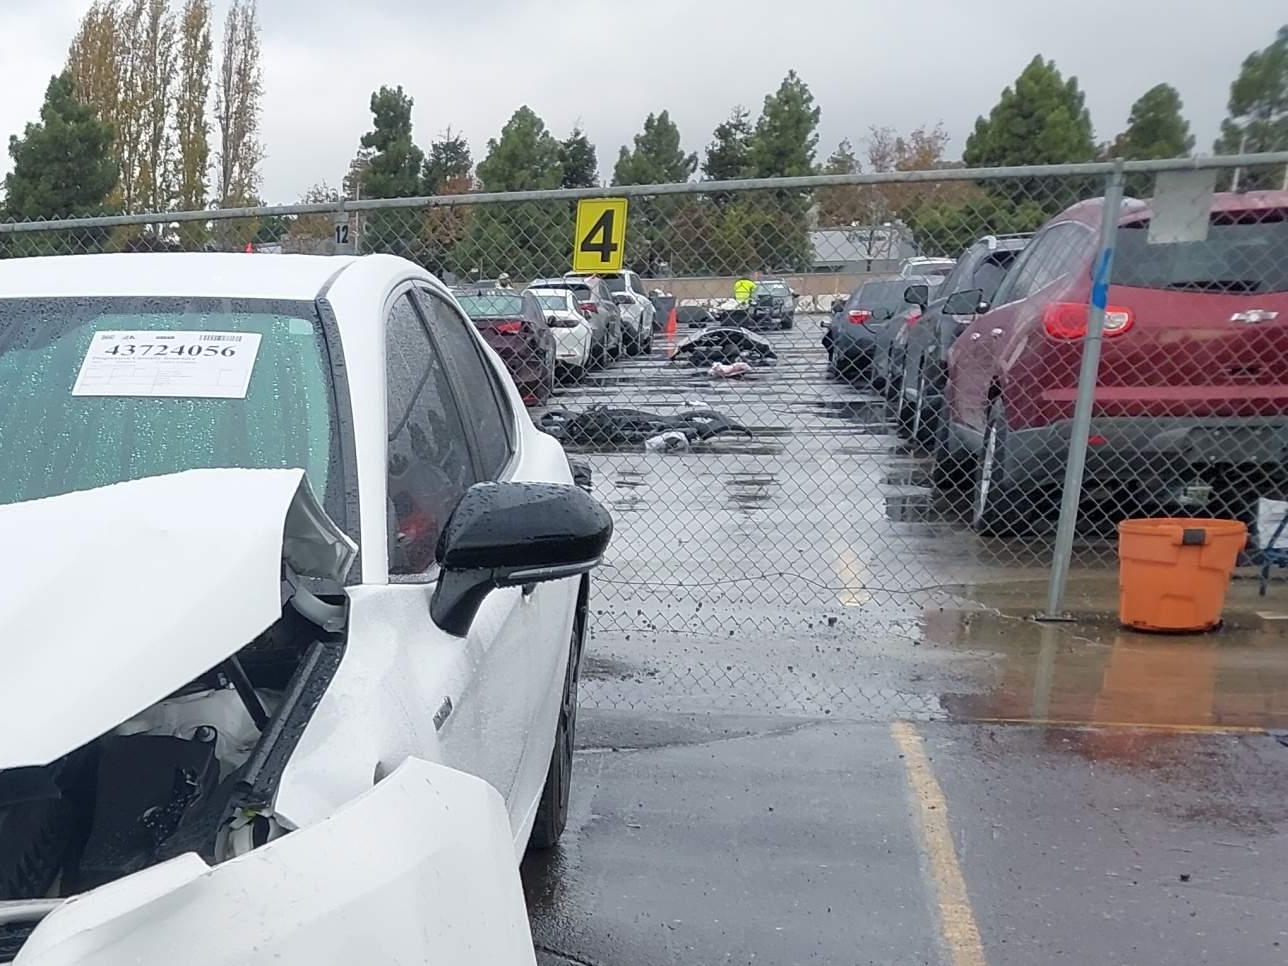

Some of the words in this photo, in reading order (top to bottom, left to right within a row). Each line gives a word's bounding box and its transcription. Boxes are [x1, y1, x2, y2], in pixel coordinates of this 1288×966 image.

[336, 225, 349, 243] 12
[581, 209, 618, 262] 4
[104, 344, 236, 358] 43724056
